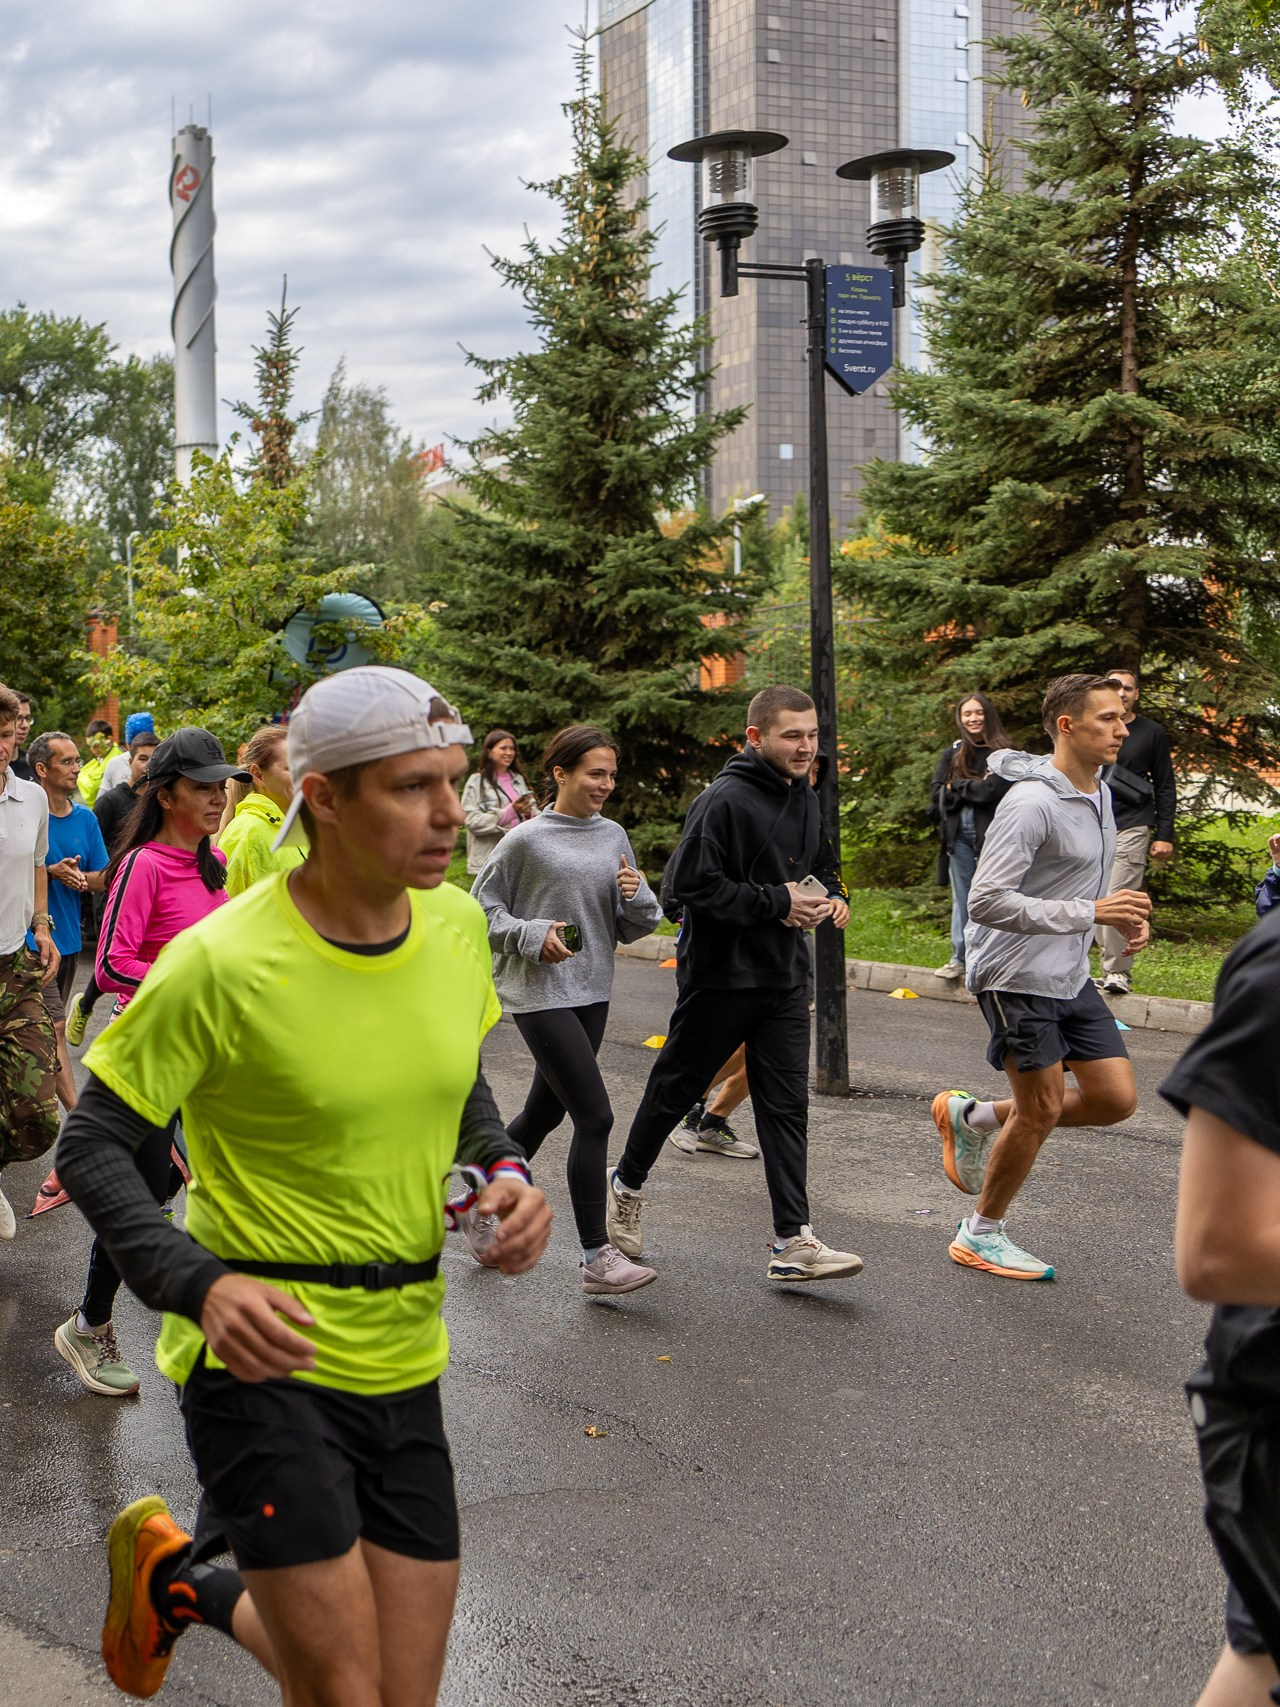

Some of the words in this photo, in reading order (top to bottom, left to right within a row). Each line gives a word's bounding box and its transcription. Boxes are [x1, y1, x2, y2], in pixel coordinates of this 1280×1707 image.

[844, 273, 851, 282] 5
[852, 272, 874, 283] вёрст
[843, 363, 876, 374] 5verst.ru
